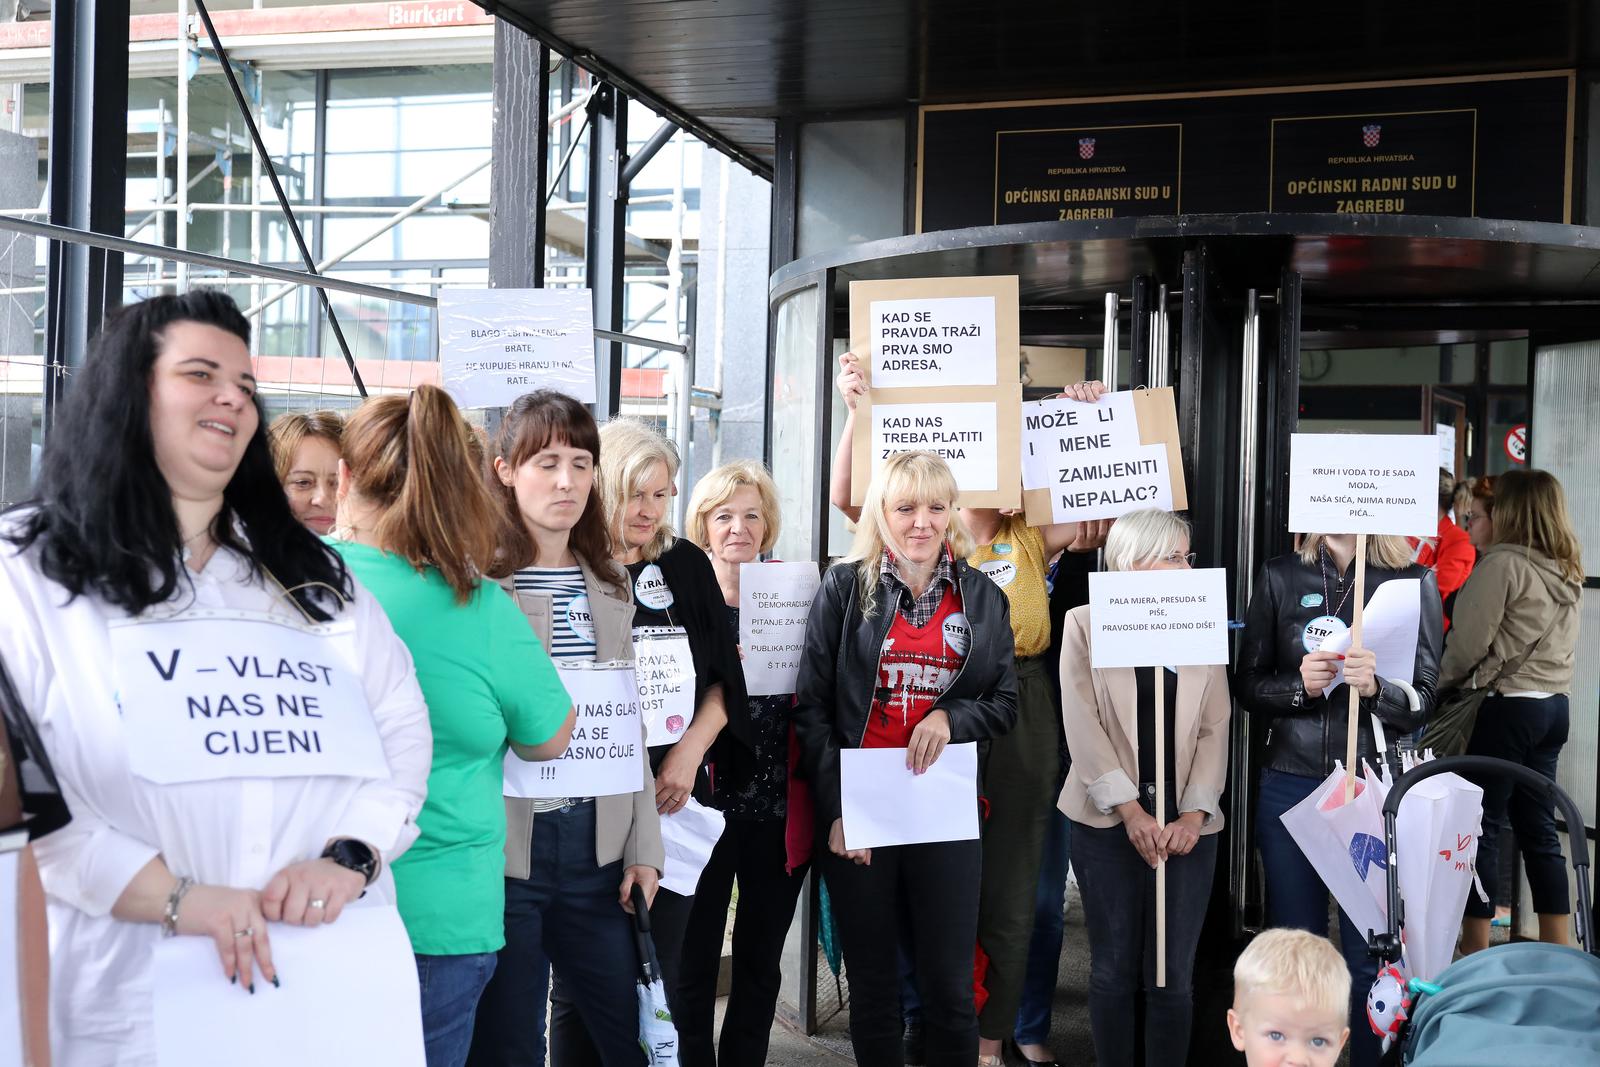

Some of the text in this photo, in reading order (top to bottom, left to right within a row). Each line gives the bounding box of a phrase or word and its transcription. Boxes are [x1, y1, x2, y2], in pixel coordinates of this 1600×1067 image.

[388, 4, 465, 25] Burkart
[1328, 154, 1414, 164] REPUBLIKA HRVATSKA
[1047, 167, 1087, 175] REPUBLIKA
[1287, 175, 1457, 194] OPĆINSKI RADNI SUD U
[1005, 185, 1171, 203] OPĆINSKI GRAĐANSKI SUD U
[1336, 199, 1405, 213] ZAGREBU
[881, 311, 932, 323] KAD SE
[470, 329, 500, 338] BLAGO
[881, 323, 981, 338] PRAVDA TRAŽI
[505, 344, 535, 353] BRATE,
[882, 343, 953, 355] PRVA SMO
[519, 361, 549, 370] HRANU
[881, 359, 942, 371] ADRESA,
[883, 416, 943, 428] KAD NAS
[1026, 407, 1114, 430] MOŽE LI
[882, 431, 983, 443] TREBA PLATITI
[1029, 433, 1111, 456] I MENE
[1059, 459, 1158, 484] ZAMIJENITI
[1312, 468, 1336, 476] KRUH
[1342, 468, 1367, 476] VODA
[1369, 469, 1380, 477] TO
[1382, 469, 1391, 477] JE
[1392, 469, 1416, 477] SADA
[1348, 482, 1378, 490] MODA,
[1062, 485, 1158, 509] NEPALAC?
[1309, 494, 1417, 505] NAŠA SIĆA, NJIMA RUNDA
[984, 564, 1012, 577] TRAJK
[752, 592, 779, 600] ŠTO JE
[1130, 596, 1159, 604] MJERA,
[1160, 595, 1196, 604] PRESUDA
[1197, 595, 1207, 603] SE
[568, 609, 592, 622] ŠTR
[1149, 608, 1168, 617] PIŠE,
[944, 622, 970, 635] ŠTRA
[1195, 620, 1216, 629] DIŠE!
[751, 644, 784, 652] PUBLIKA
[639, 654, 677, 666] RAVDA
[147, 648, 181, 681] V
[227, 655, 333, 687] VLAST
[639, 683, 681, 696] OSTAJE
[187, 693, 323, 719] NAS NE
[585, 701, 613, 717] NAŠ
[615, 702, 637, 716] GLAS
[641, 698, 665, 711] OST
[591, 727, 609, 740] SE
[204, 729, 322, 755] CIJENI
[609, 743, 634, 758] ČUJE
